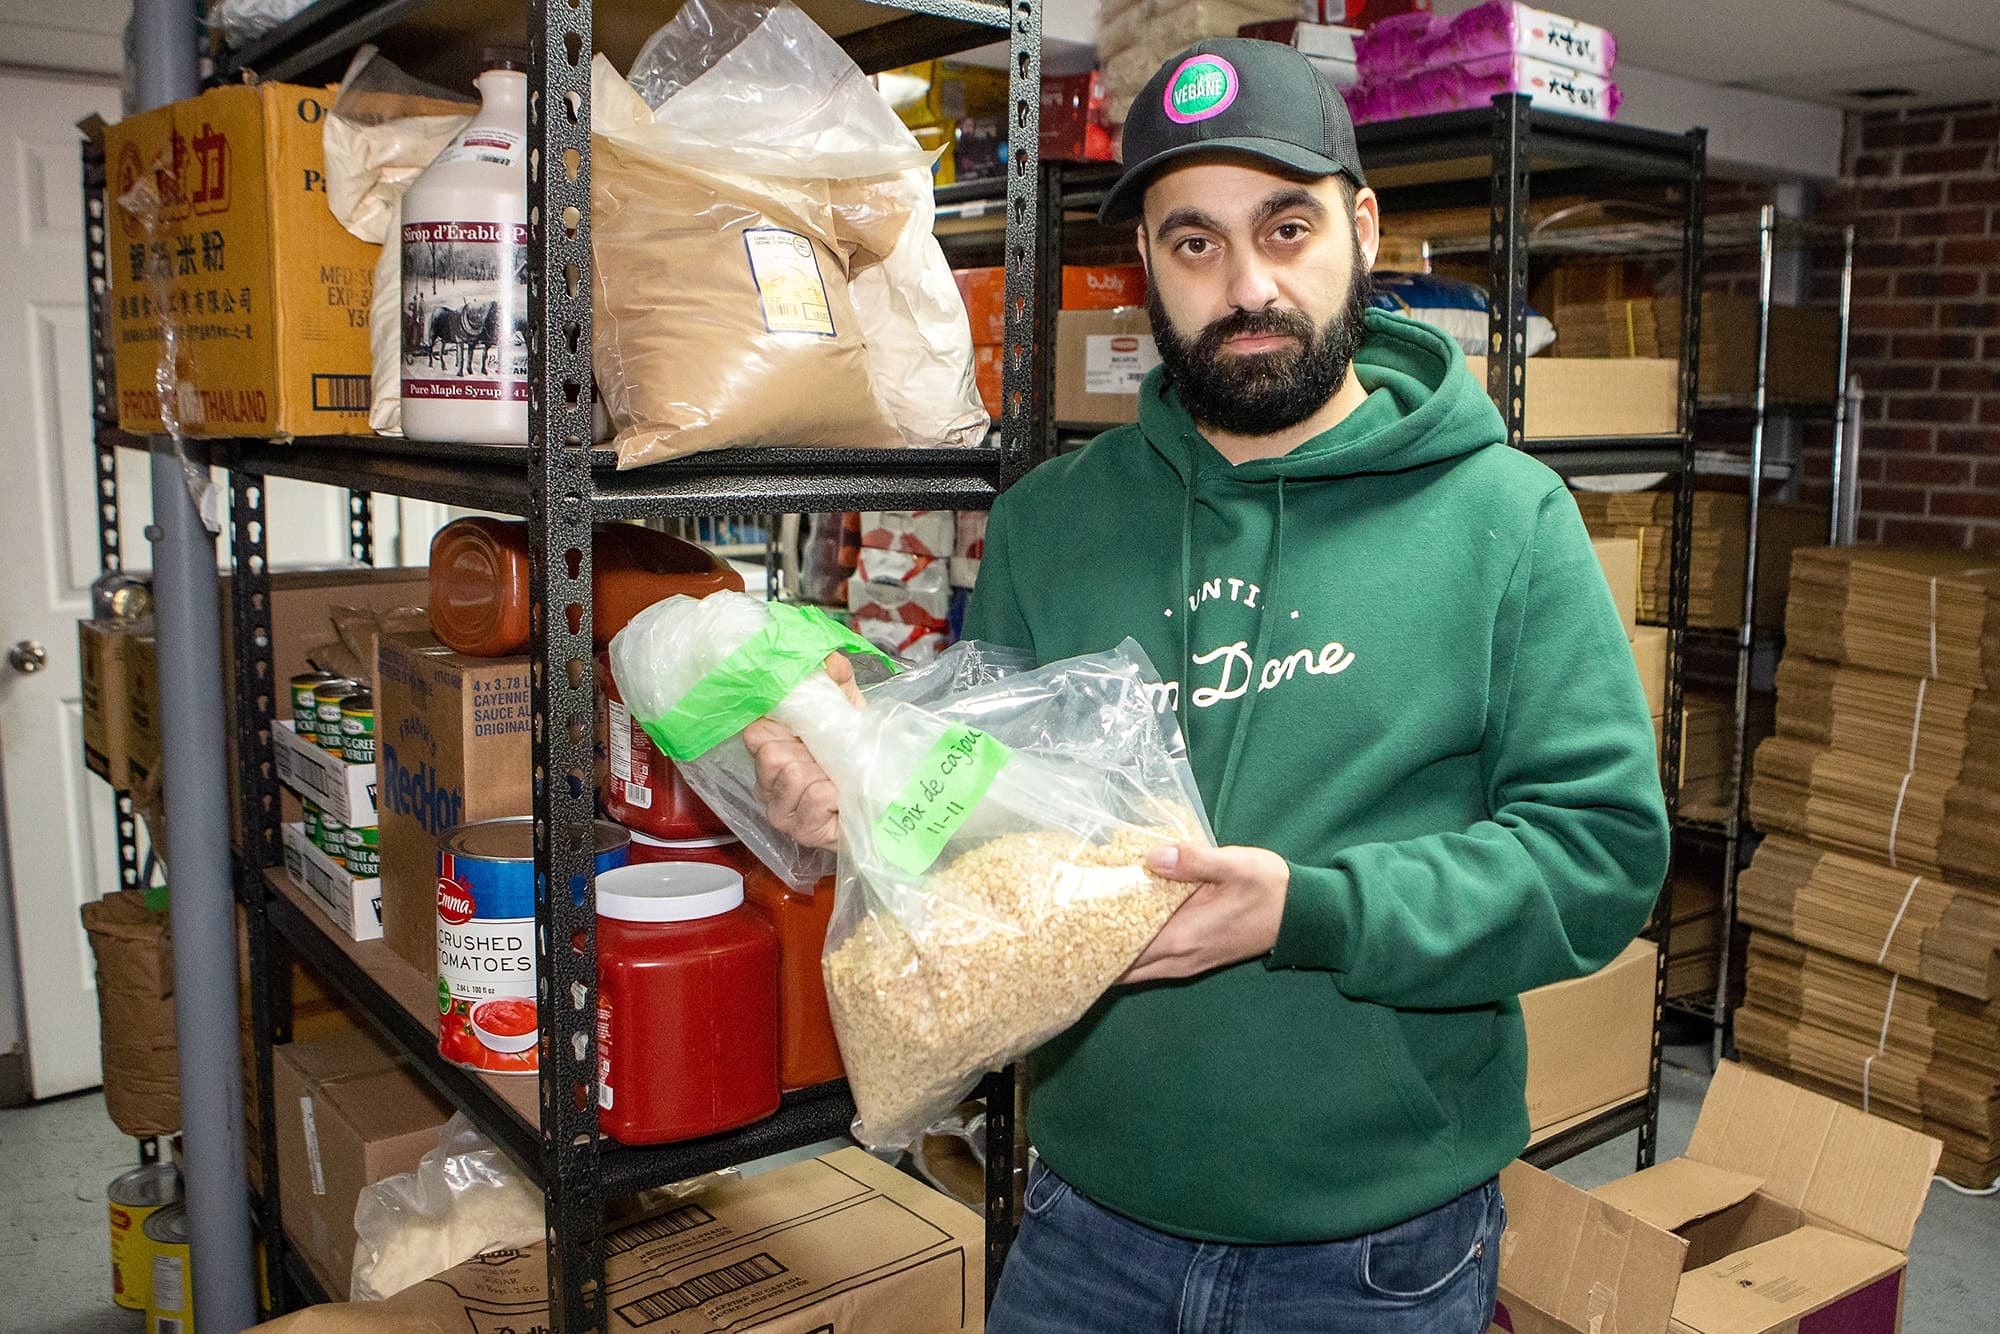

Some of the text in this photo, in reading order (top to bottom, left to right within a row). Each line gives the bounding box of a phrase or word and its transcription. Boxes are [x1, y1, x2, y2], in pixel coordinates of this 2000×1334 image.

[403, 226, 430, 244] Sirop
[1086, 271, 1125, 295] bubly
[410, 383, 429, 395] Pure
[430, 384, 463, 398] Maple
[464, 384, 502, 398] Syrup
[1188, 577, 1265, 612] UNTI
[1192, 640, 1356, 708] Done
[473, 679, 481, 692] 4
[484, 682, 491, 692] x
[494, 676, 520, 691] 3.78
[474, 690, 529, 707] CAYENNE
[474, 707, 513, 722] SAUCE
[882, 730, 984, 843] Noix de cajou
[438, 929, 523, 951] CRUSHED
[472, 985, 482, 993] 100
[691, 1225, 730, 1240] CANADA
[750, 1288, 763, 1298] AU
[764, 1275, 802, 1294] CANADA
